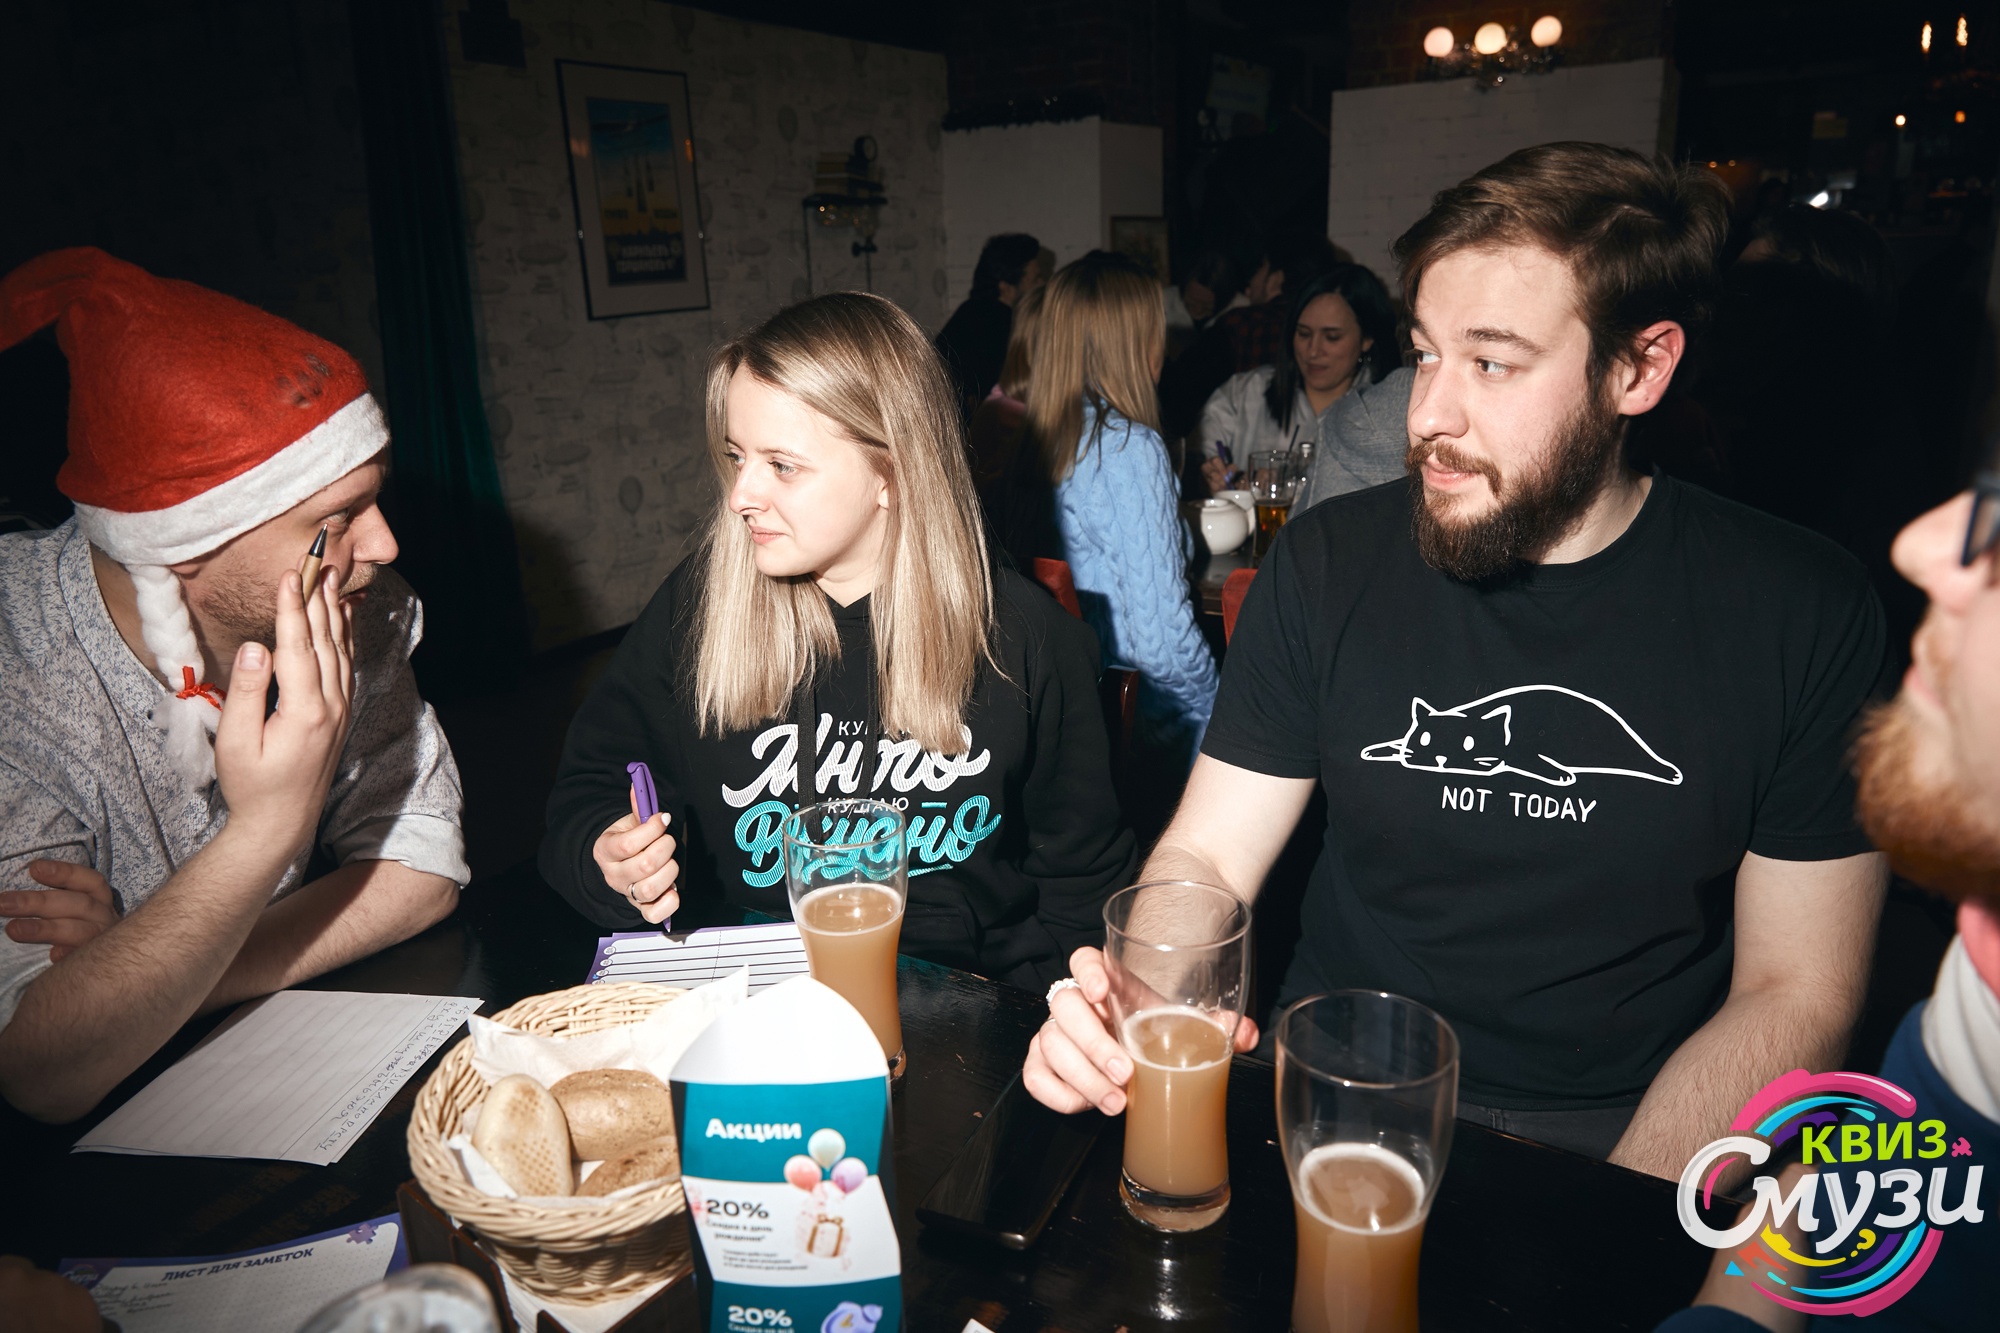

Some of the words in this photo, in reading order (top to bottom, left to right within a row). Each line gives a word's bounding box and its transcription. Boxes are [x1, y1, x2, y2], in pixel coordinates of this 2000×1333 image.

[1441, 785, 1493, 812] NOT
[1508, 791, 1597, 823] TODAY
[705, 1117, 802, 1143] Акции
[706, 1198, 770, 1220] 20%
[160, 1266, 208, 1282] ЛИСТ
[207, 1261, 242, 1276] ДЛЯ
[243, 1247, 315, 1269] ЗАМЕТОК
[728, 1304, 793, 1328] 20%
